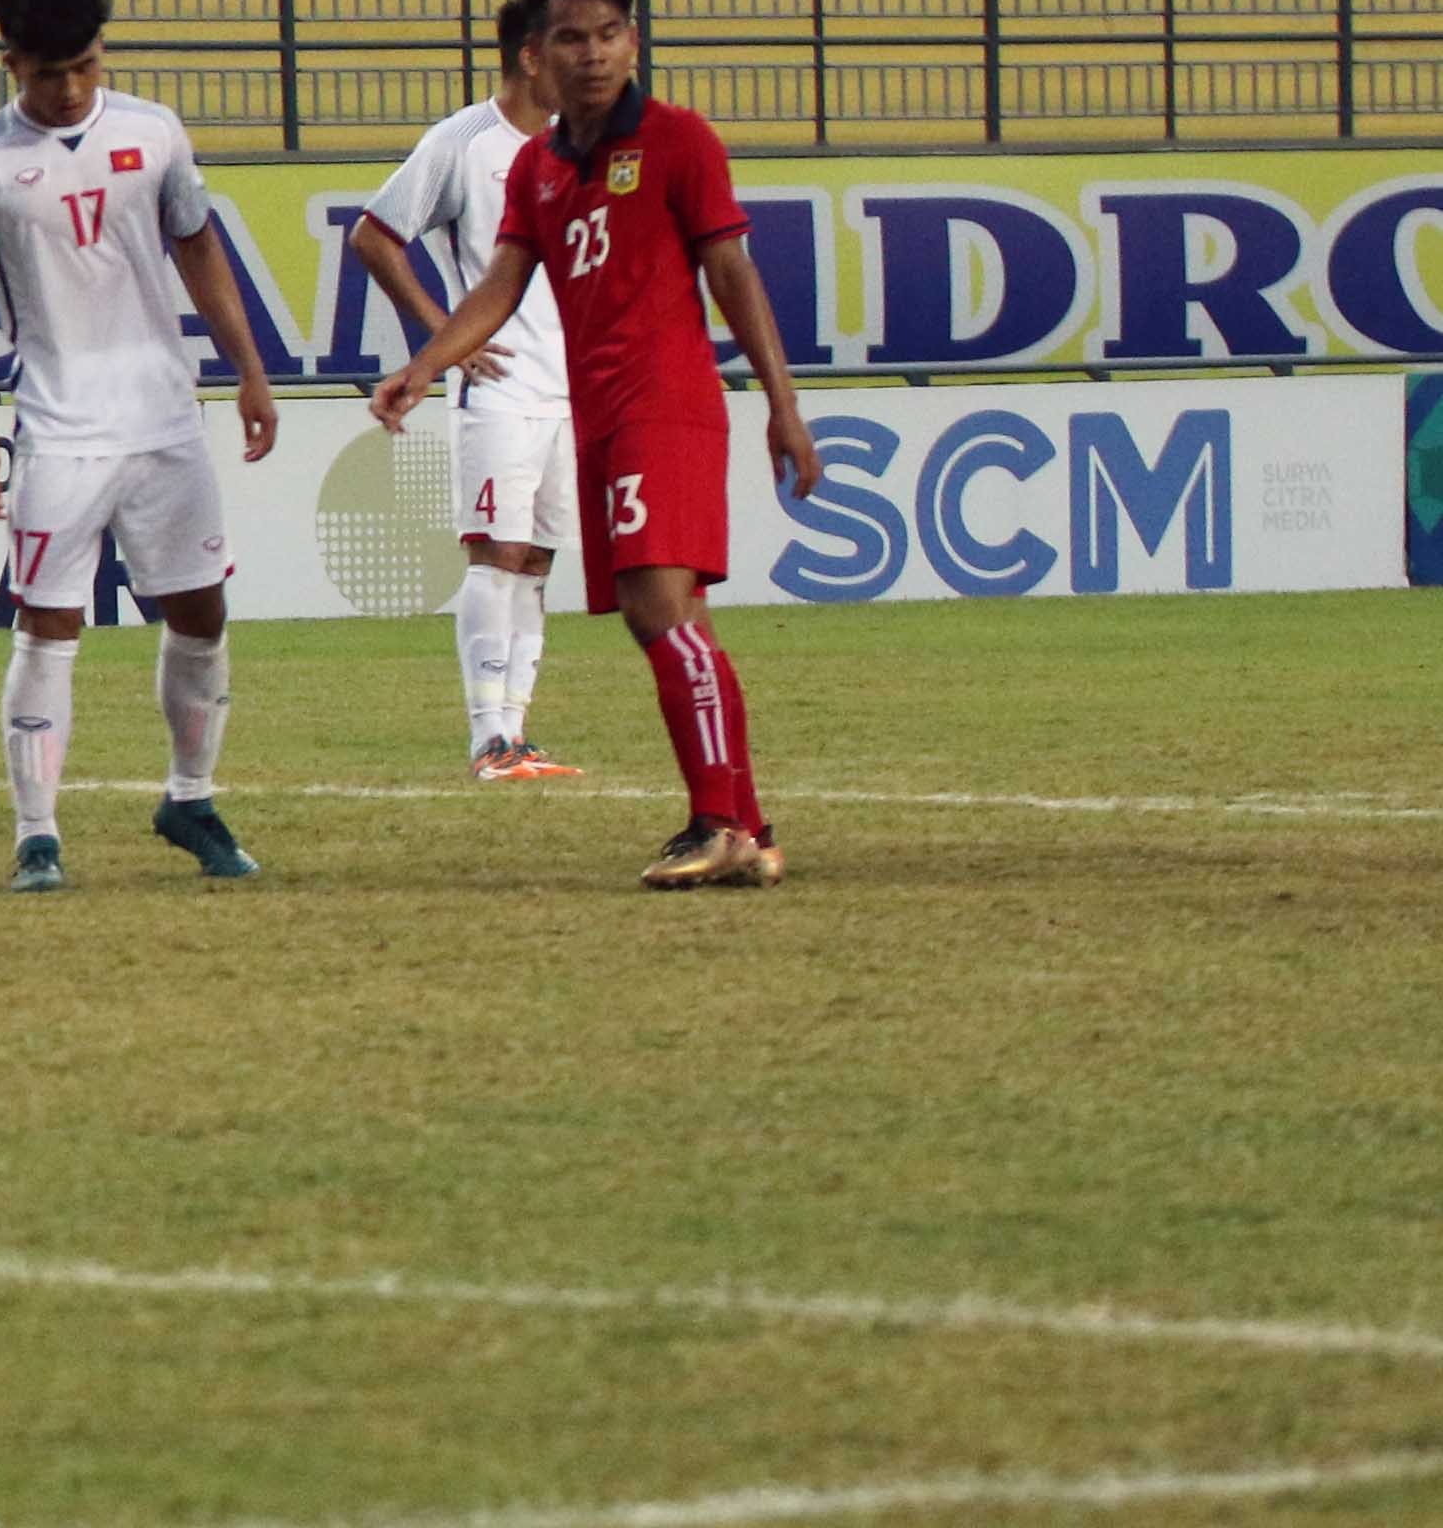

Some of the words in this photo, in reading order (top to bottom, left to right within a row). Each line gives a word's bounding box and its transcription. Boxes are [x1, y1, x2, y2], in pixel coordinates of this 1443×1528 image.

[60, 187, 107, 248] 17
[565, 205, 611, 279] 23
[475, 477, 498, 524] 4
[768, 408, 1234, 603] SCM
[1261, 486, 1332, 506] CITRA
[1261, 509, 1332, 531] MEDIA
[14, 530, 53, 586] 17
